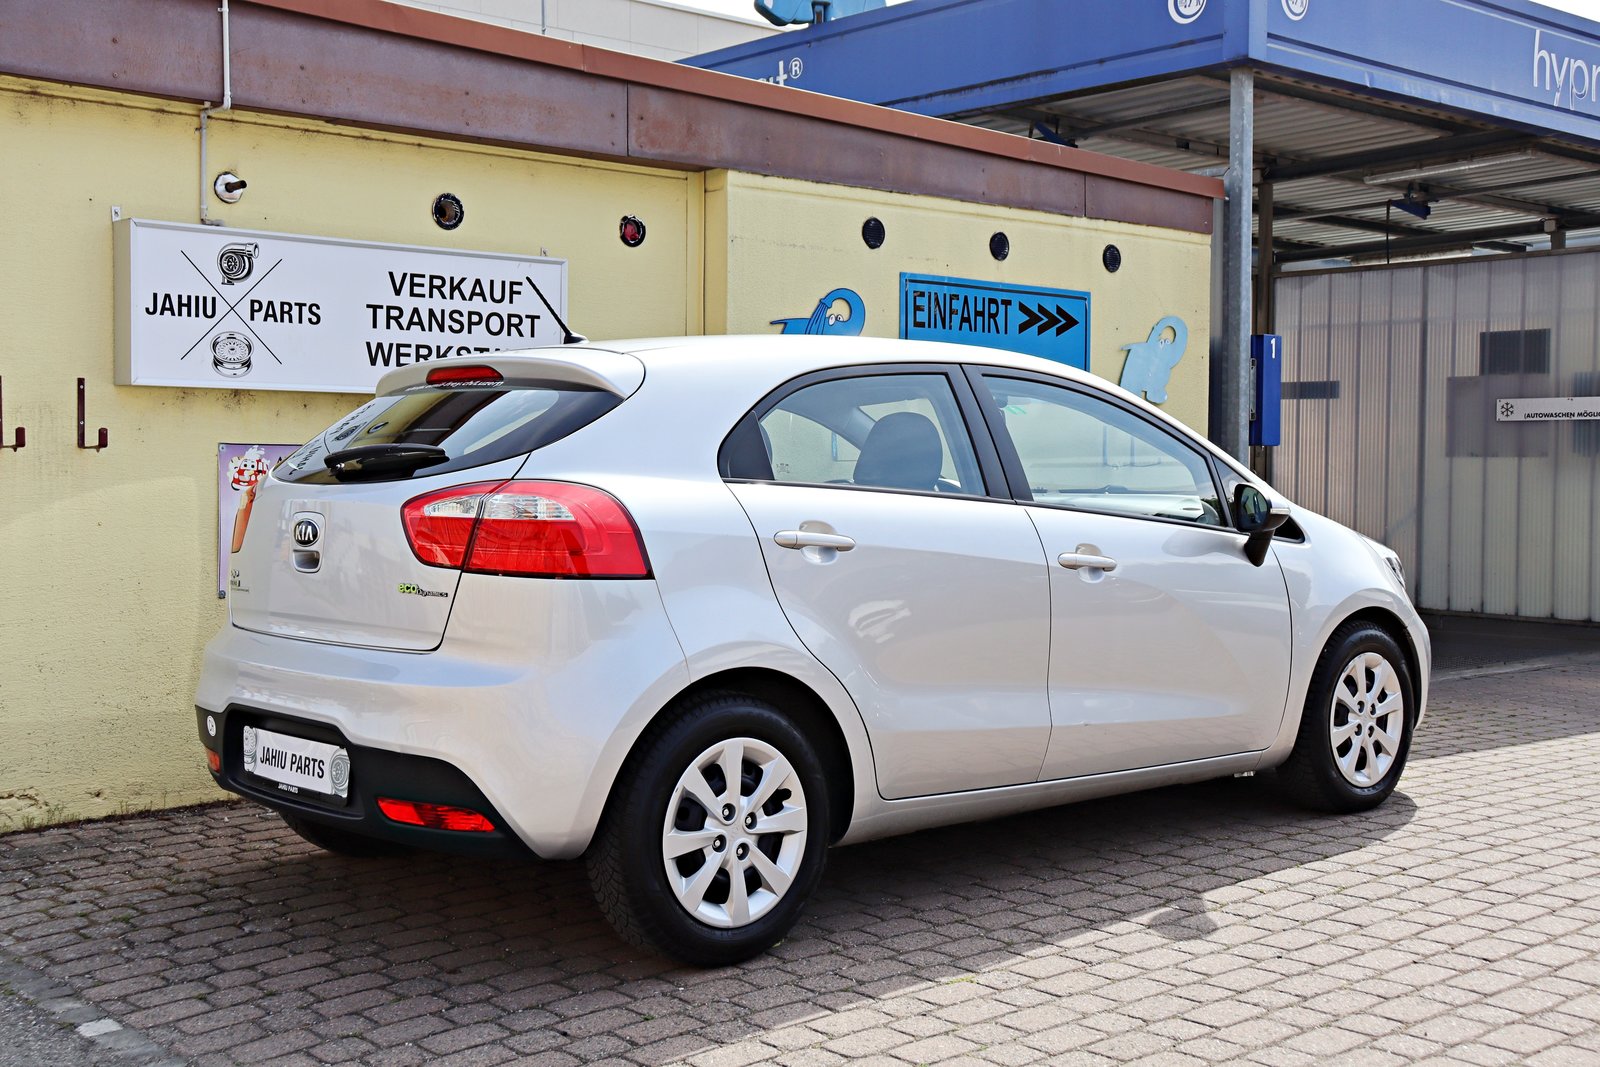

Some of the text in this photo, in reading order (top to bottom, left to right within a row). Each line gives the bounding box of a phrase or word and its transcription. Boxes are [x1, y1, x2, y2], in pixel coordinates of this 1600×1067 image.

[388, 271, 523, 304] VERKAUF
[145, 292, 321, 325] JAHIU PARTS
[366, 304, 541, 338] TRANSPORT
[913, 291, 1012, 335] EINFAHRT
[1270, 337, 1276, 359] 1
[295, 525, 313, 541] KIA
[260, 746, 325, 779] JAHIU PARTS
